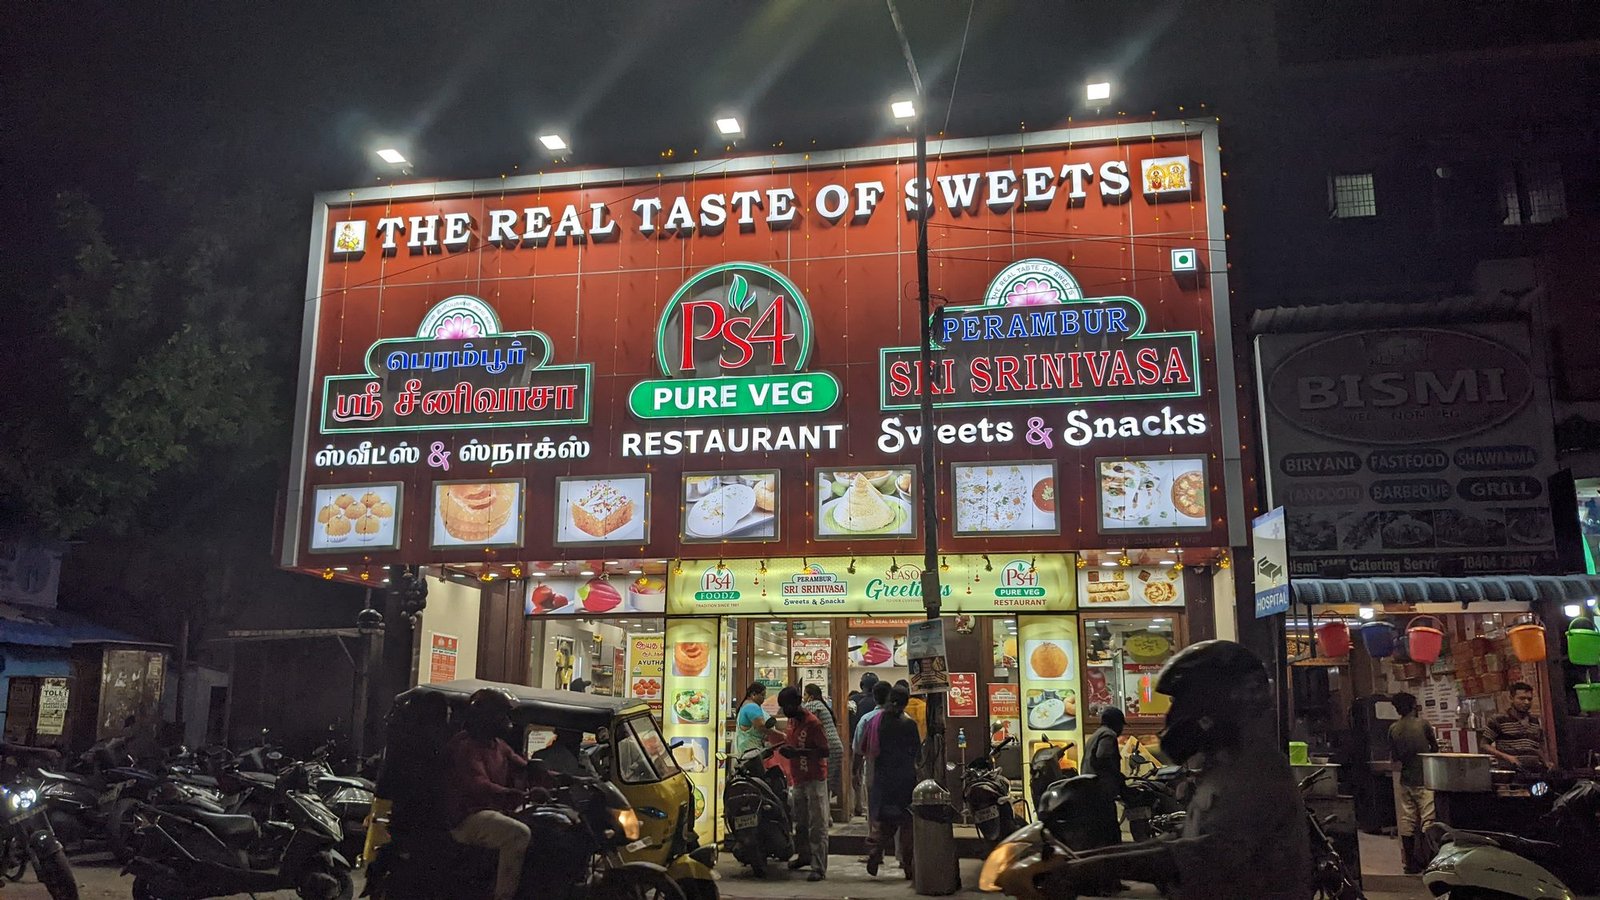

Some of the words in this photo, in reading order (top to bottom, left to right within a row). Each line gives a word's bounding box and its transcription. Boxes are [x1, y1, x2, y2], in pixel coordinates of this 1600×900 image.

[377, 211, 470, 250] THE
[488, 202, 616, 243] REAL
[633, 186, 796, 233] TASTE
[815, 180, 885, 220] OF
[904, 160, 1130, 211] SWEETS
[1001, 273, 1016, 286] REAL
[1017, 264, 1040, 274] TASTE
[1042, 265, 1054, 273] OF
[1053, 271, 1075, 296] SWEETS
[680, 293, 796, 372] Ps4
[942, 306, 1130, 344] PERAMBUR
[386, 340, 528, 374] பெரம்பூர்
[970, 346, 1191, 394] SRINIVASA
[393, 378, 579, 417] சீனிவாசா
[653, 383, 736, 411] PURE
[747, 381, 813, 407] VEG
[1300, 369, 1508, 409] BISMI
[621, 423, 844, 457] RESTAURANT
[1025, 416, 1054, 450] &
[1063, 406, 1207, 447] Snacks
[315, 440, 420, 468] ஸ்வீட்ஸ்
[428, 440, 451, 471] &
[459, 434, 591, 468] ஸ்நாக்ஸ்
[1285, 457, 1356, 473] BIRYANI
[1469, 481, 1532, 498] GRILL
[797, 575, 832, 583] PERAMBUR
[1006, 567, 1035, 586] Ps4
[1290, 559, 1318, 574] ismi
[1350, 556, 1401, 574] Catering
[700, 591, 735, 600] FOODZ
[705, 572, 731, 591] Ps4
[783, 585, 799, 594] SRI
[801, 584, 845, 594] SRINIVASA
[1023, 588, 1040, 596] VEG
[783, 598, 810, 606] Sweets
[819, 597, 846, 605] Snacks
[1256, 591, 1288, 611] HOSPITAL
